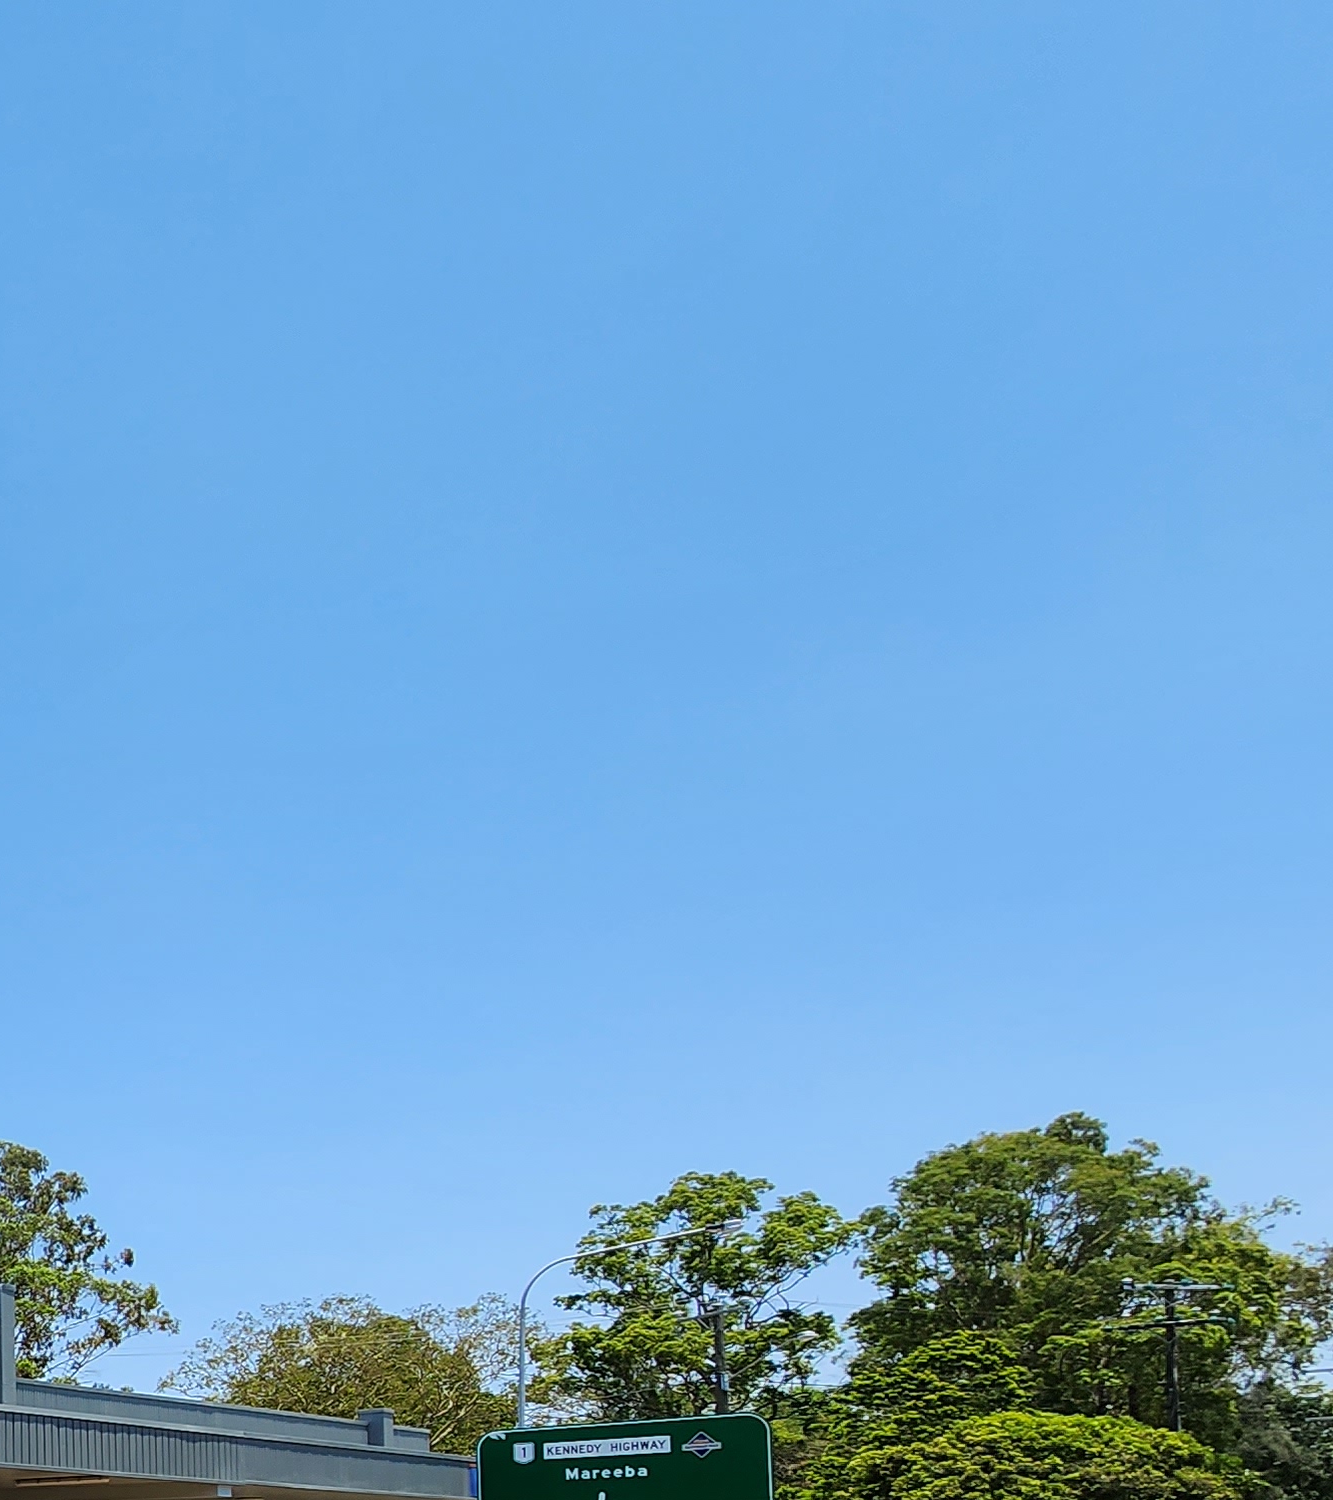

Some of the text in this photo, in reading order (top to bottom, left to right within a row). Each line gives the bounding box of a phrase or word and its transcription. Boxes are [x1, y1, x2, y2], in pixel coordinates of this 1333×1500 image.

[546, 1439, 666, 1456] KENNEDY HIGHWAY
[565, 1465, 648, 1481] Mareeba
